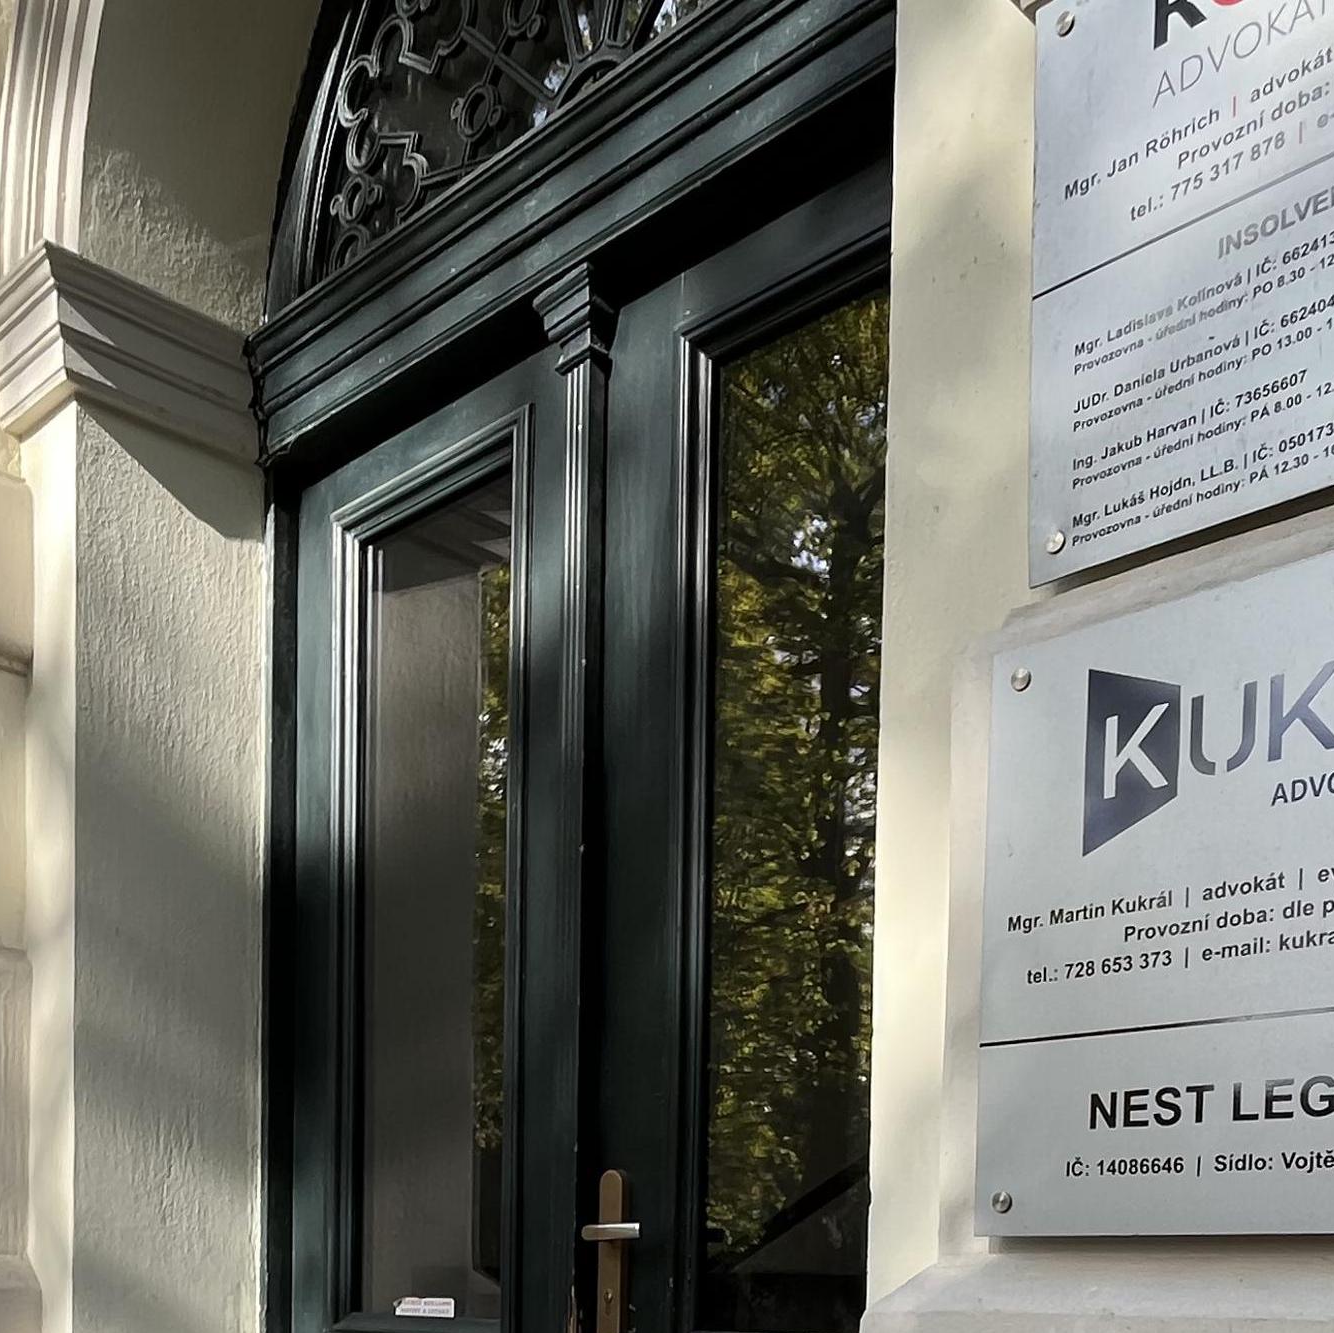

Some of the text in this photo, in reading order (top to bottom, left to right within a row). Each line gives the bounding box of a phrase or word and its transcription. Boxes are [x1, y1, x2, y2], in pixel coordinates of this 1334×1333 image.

[1064, 172, 1101, 201] Mgr.
[1106, 151, 1139, 178] Jan
[1145, 108, 1220, 158] Röhrich
[1250, 46, 1333, 103] advokát
[1177, 109, 1265, 170] Provozní
[1270, 81, 1330, 122] doba:
[1130, 193, 1164, 222] tel.:
[1170, 171, 1204, 202] 775
[1209, 150, 1244, 182] 317
[1250, 130, 1286, 162] 878
[1074, 337, 1103, 357] Mgr.
[1107, 308, 1174, 343] Ladislava
[1255, 257, 1277, 278] IČ:
[1074, 338, 1144, 376] Provozovna
[1155, 312, 1196, 341] úřední
[1198, 292, 1248, 323] hodiny:
[1252, 280, 1274, 299] PO
[1277, 266, 1306, 289] 8.30
[1073, 391, 1109, 414] JUDr.
[1113, 368, 1166, 397] Daniela
[1170, 337, 1241, 374] Urbanová
[1253, 318, 1275, 340] IČ:
[1073, 397, 1144, 433] Provozovna
[1154, 373, 1195, 400] úřední
[1198, 355, 1247, 382] hodiny:
[1251, 343, 1272, 361] PO
[1276, 326, 1313, 350] 13.00
[1072, 368, 1308, 471] Ing. Jakub Harvan IČ: 73656607
[1072, 456, 1142, 490] Provozovna
[1153, 433, 1194, 459] úřední
[1197, 416, 1246, 443] hodiny:
[1250, 404, 1271, 423] PÁ
[1273, 393, 1302, 414] 8.00
[1071, 515, 1141, 547] Provozovna
[1152, 493, 1193, 519] úřední
[1196, 478, 1245, 504] hodiny:
[1249, 464, 1269, 484] PÁ
[1273, 453, 1309, 475] 12.30
[1072, 511, 1100, 529] Mgr.
[1104, 490, 1146, 517] Lukáš
[1252, 442, 1274, 464] IČ:
[1007, 915, 1044, 934] Mgr.
[1049, 903, 1105, 926] Martin
[1111, 890, 1173, 916] Kukrál
[1202, 871, 1285, 901] advokát
[1124, 913, 1210, 943] Provozní
[1216, 908, 1275, 929] doba:
[1282, 899, 1315, 919] dle
[1026, 966, 1058, 985] tel.:
[1064, 960, 1095, 980] 728
[1101, 955, 1133, 975] 653
[1139, 949, 1172, 970] 373
[1201, 936, 1271, 962] e-mail:
[1089, 1084, 1215, 1130] NEST
[1066, 1156, 1090, 1177] IČ:
[1096, 1156, 1184, 1176] 14086646
[1214, 1153, 1273, 1172] Sídlo:
